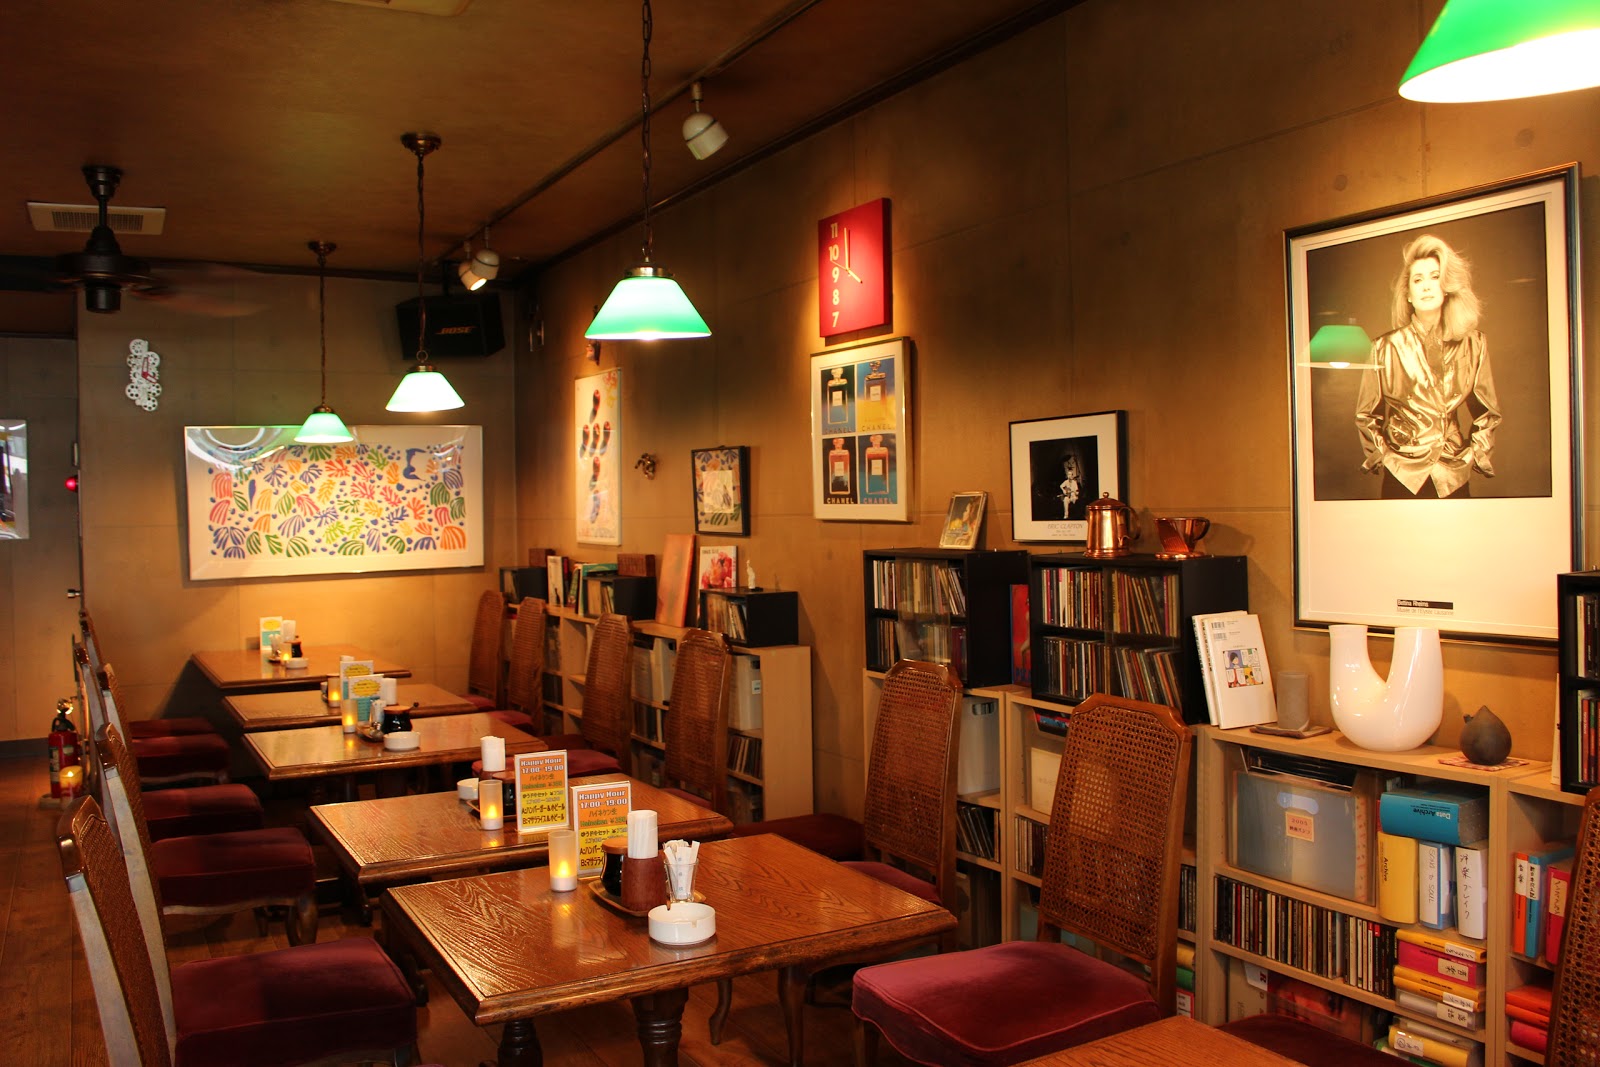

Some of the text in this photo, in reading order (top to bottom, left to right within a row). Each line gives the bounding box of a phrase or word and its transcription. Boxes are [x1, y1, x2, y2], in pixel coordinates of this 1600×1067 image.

[830, 222, 838, 239] 11
[828, 244, 840, 261] 10
[831, 266, 840, 283] 9
[832, 288, 840, 306] 8
[831, 311, 840, 328] 7
[438, 326, 474, 335] BOSE
[861, 423, 892, 432] CHANEL
[579, 790, 626, 801] Happy Hour
[1413, 808, 1451, 819] Data Archive
